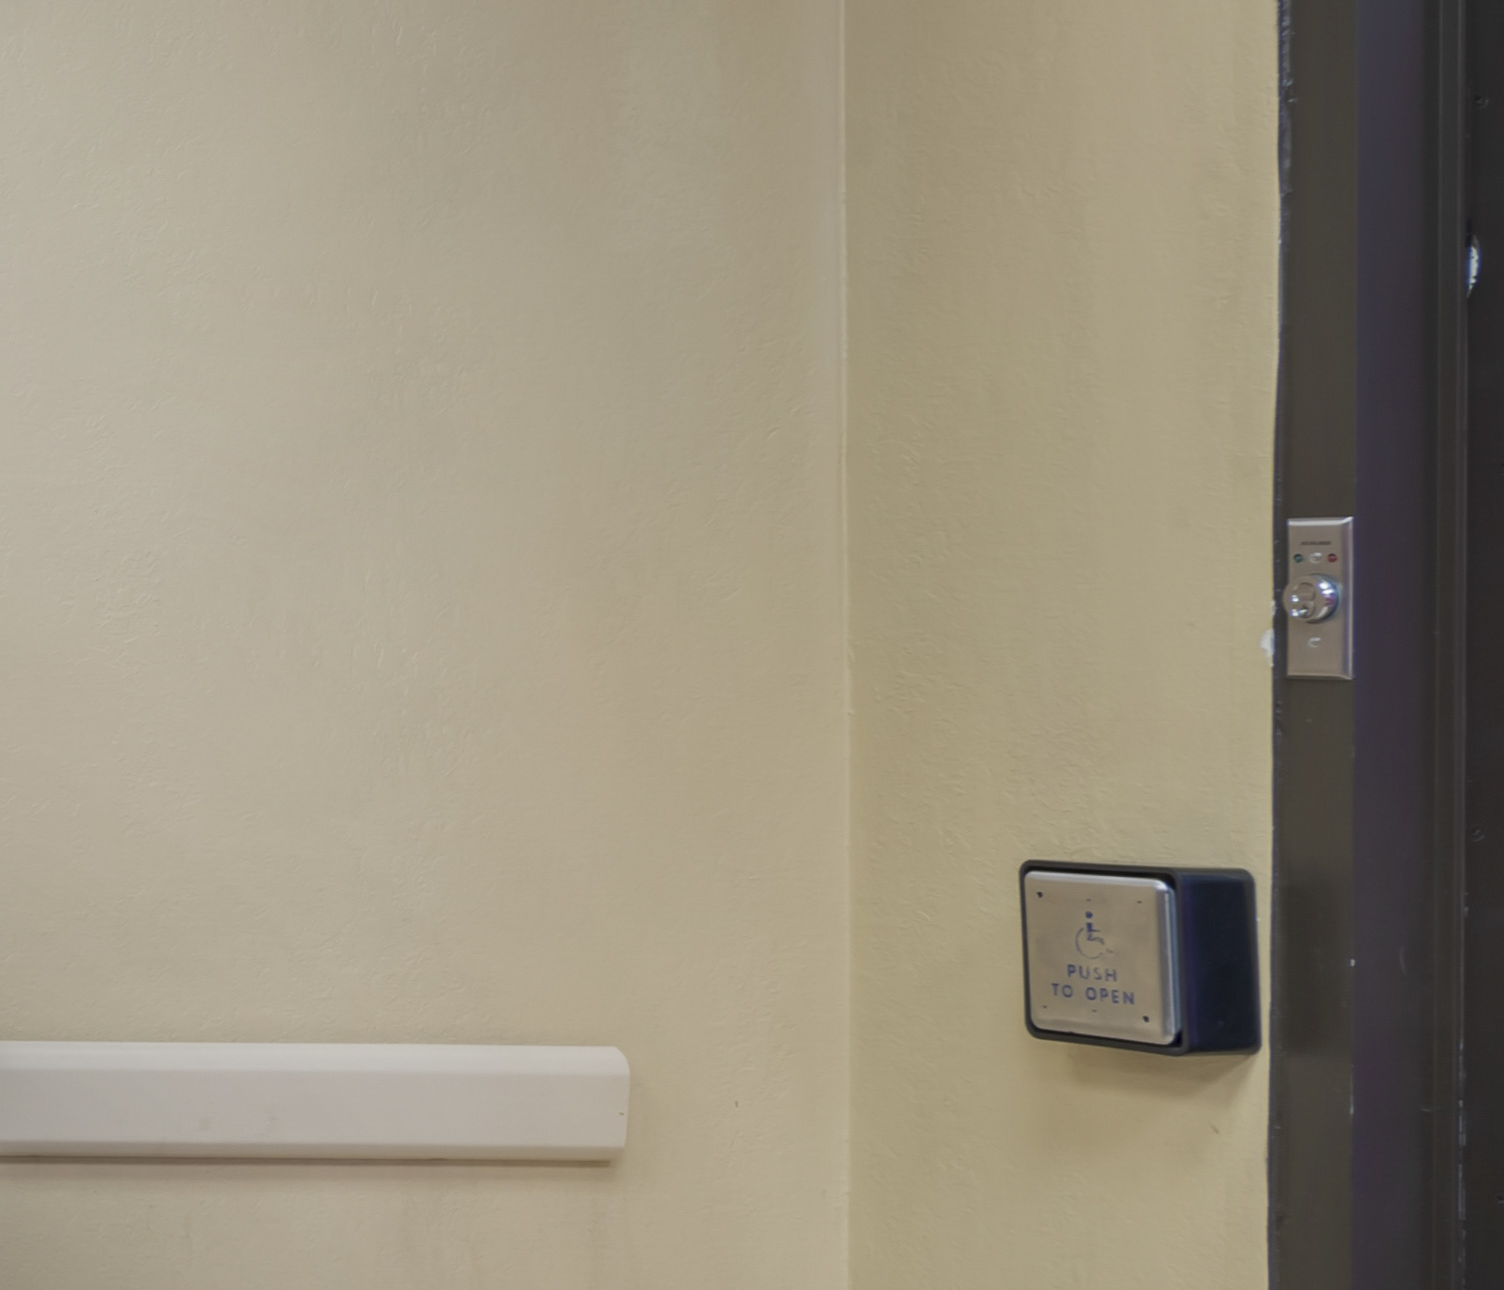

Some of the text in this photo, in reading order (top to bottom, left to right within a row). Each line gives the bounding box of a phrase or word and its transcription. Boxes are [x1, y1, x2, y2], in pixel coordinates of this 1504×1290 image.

[1067, 963, 1118, 982] PUSH
[1051, 982, 1136, 1005] TO OPEN
